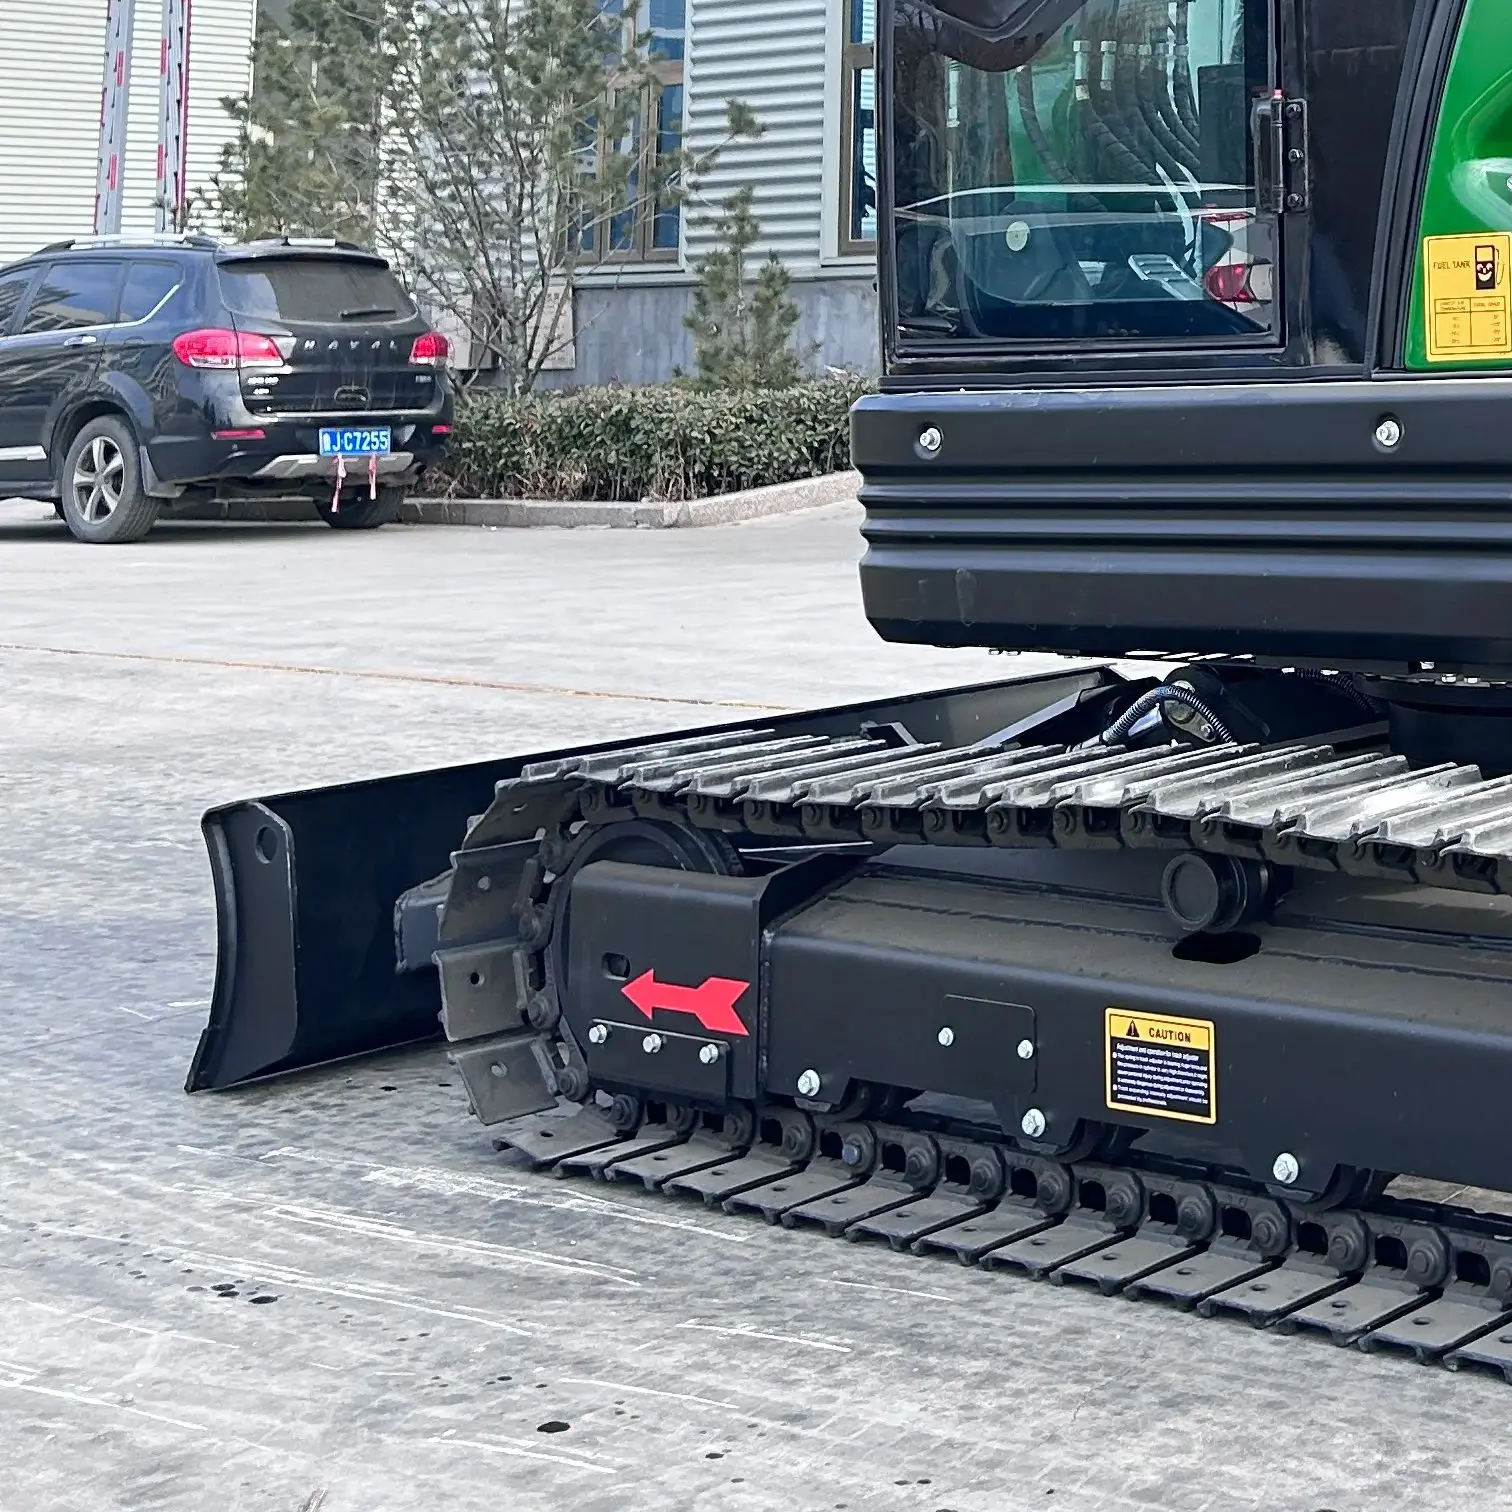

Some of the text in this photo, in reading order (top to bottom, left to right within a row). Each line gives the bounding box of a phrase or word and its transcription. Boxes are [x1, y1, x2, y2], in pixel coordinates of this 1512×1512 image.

[1432, 260, 1471, 270] FUEL TANK
[304, 339, 398, 350] HAVAL
[1149, 1027, 1191, 1043] CAUTION
